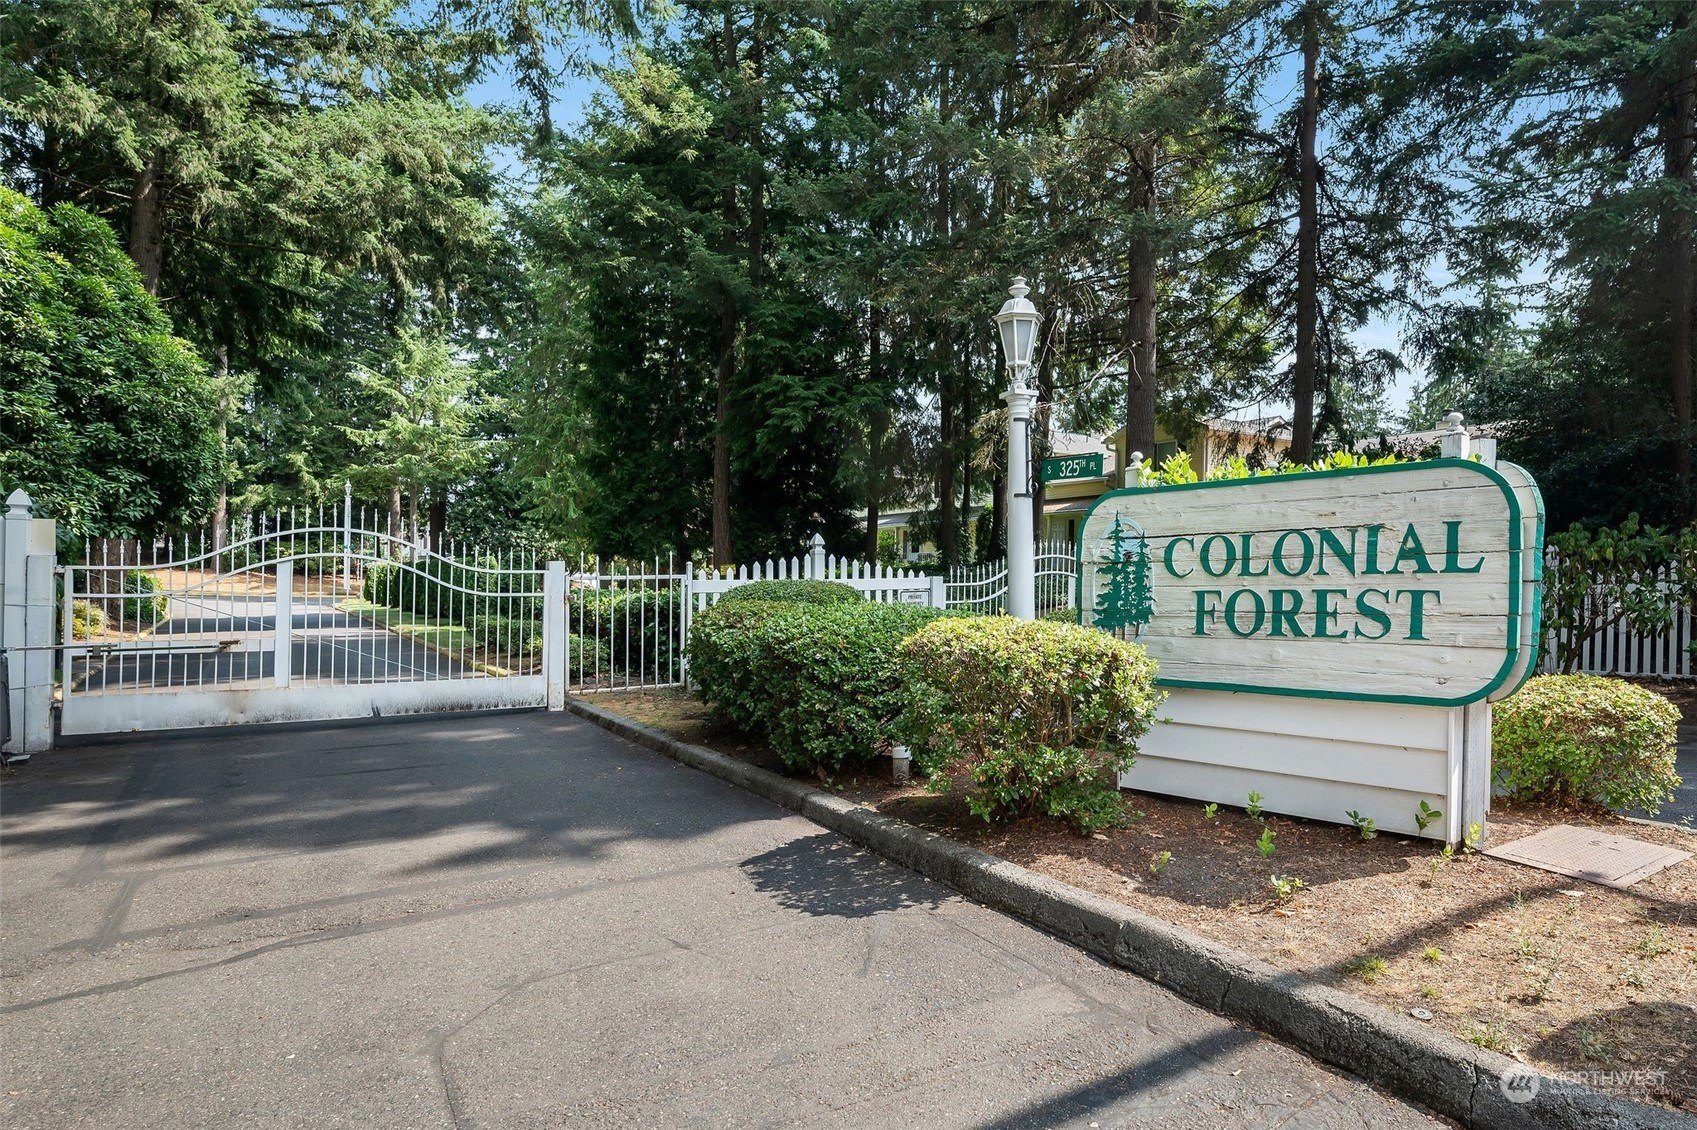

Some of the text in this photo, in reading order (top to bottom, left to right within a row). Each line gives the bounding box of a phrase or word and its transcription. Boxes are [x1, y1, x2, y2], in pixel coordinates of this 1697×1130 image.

[1048, 459, 1096, 477] S 325TH PL
[1163, 520, 1486, 578] COLONIAL
[1192, 588, 1441, 641] FOREST
